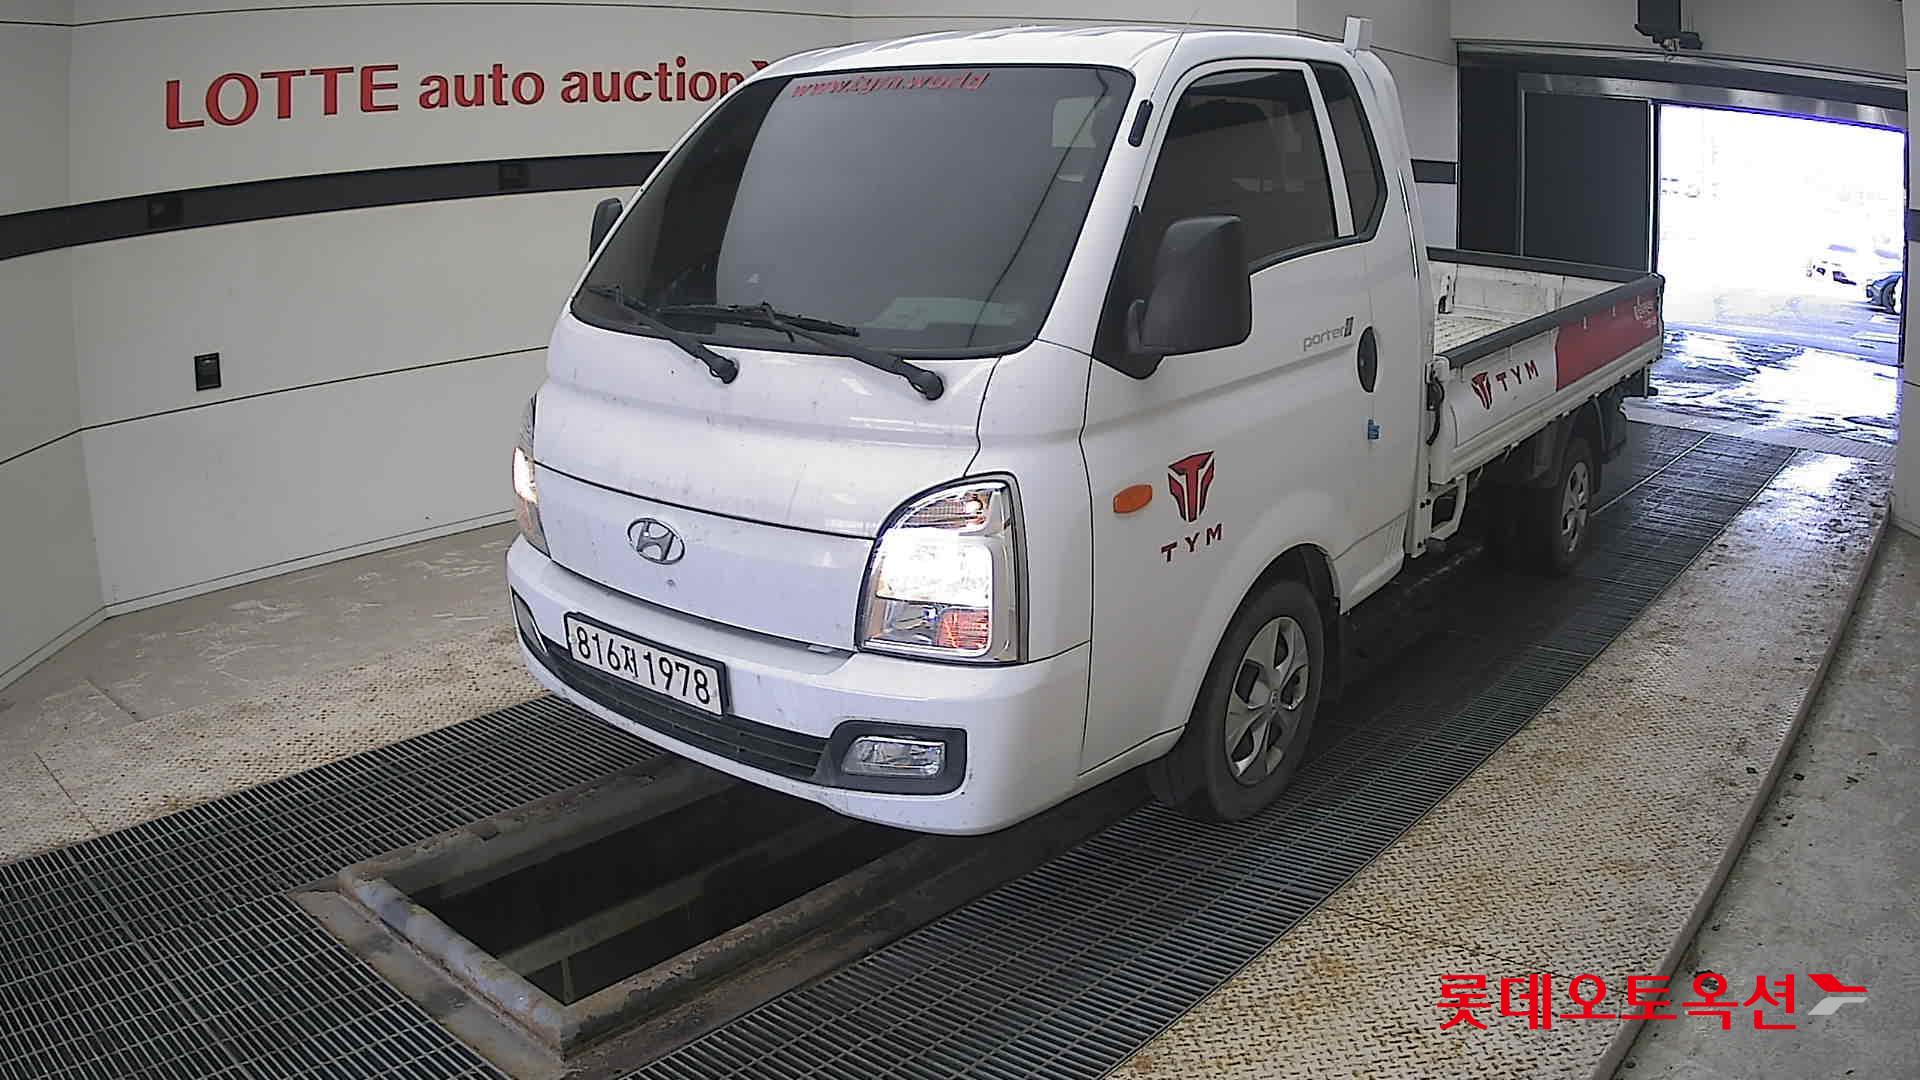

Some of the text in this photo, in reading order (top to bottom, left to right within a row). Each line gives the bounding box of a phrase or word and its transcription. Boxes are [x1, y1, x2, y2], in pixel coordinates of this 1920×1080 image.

[166, 64, 399, 130] LOTTE
[418, 63, 545, 109] auto
[1495, 359, 1539, 392] TYM
[1160, 522, 1223, 563] TYM
